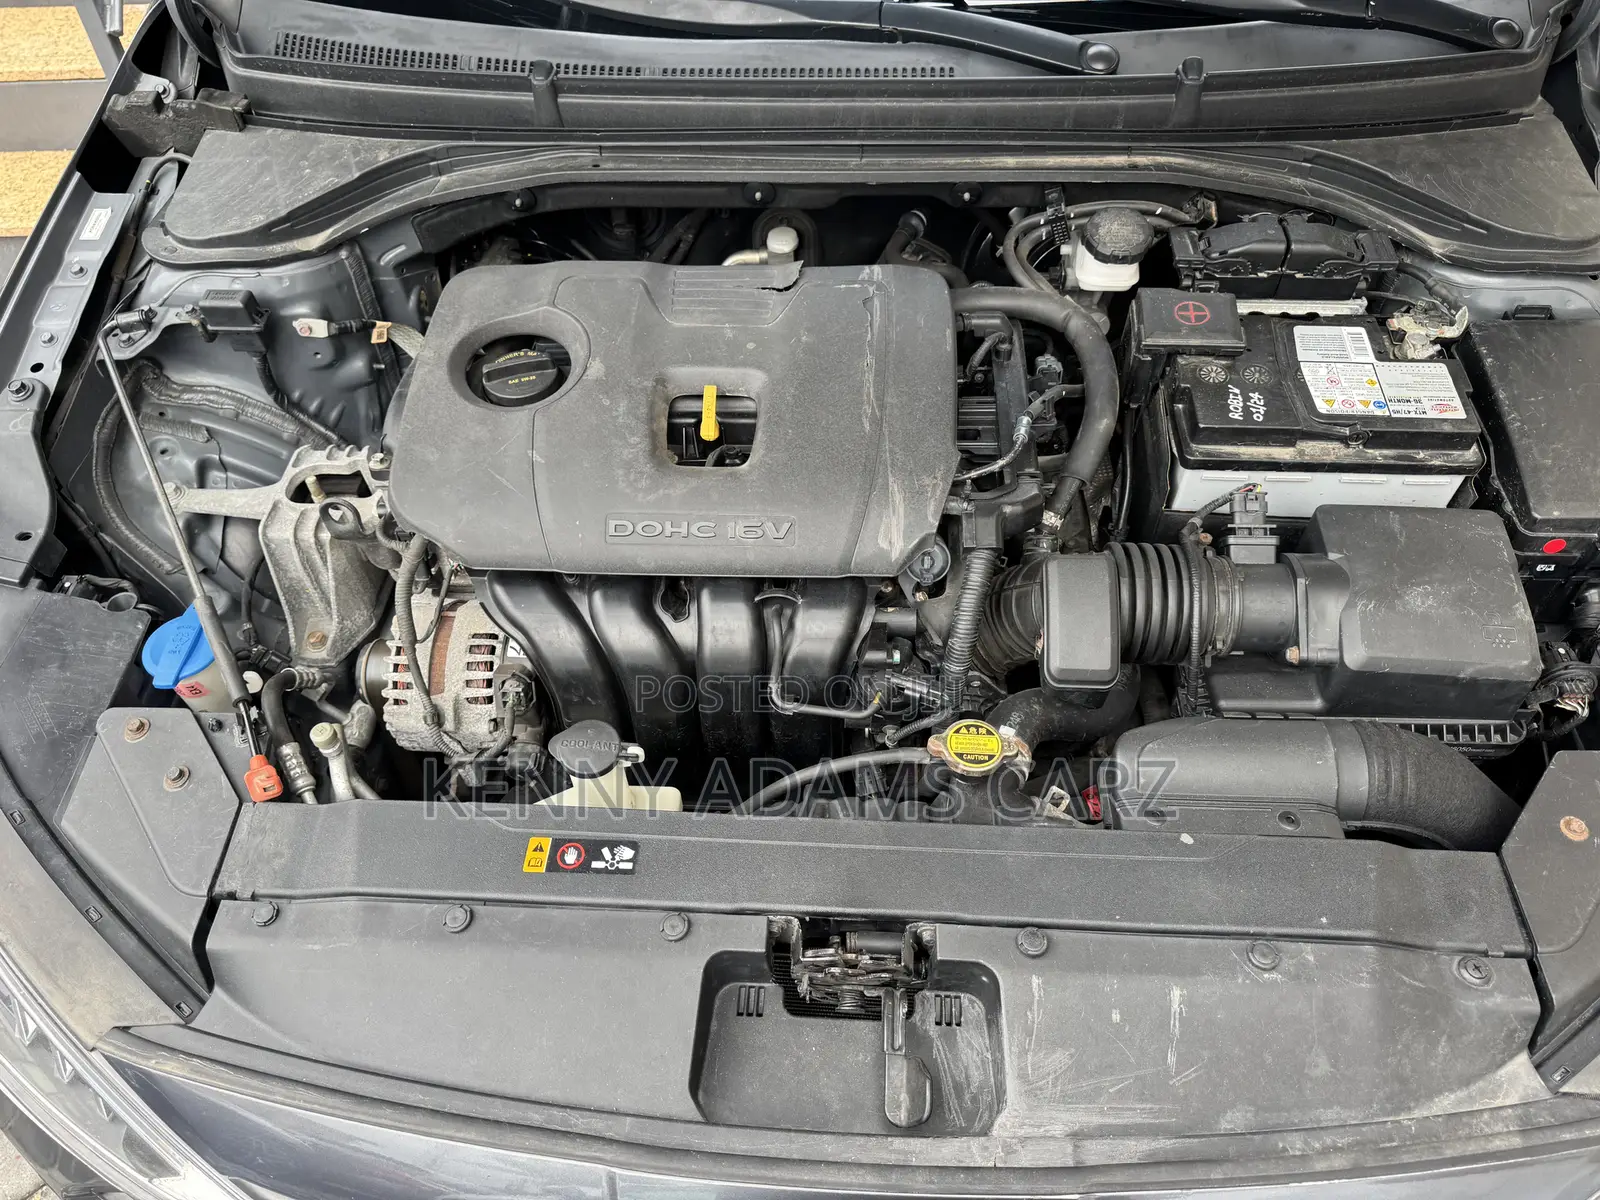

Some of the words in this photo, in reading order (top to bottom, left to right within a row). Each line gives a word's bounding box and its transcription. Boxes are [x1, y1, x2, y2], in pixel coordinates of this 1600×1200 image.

[1228, 385, 1244, 420] ROBIN
[608, 519, 718, 539] DOHC
[726, 521, 794, 540] 16V
[560, 740, 620, 752] COOLANT
